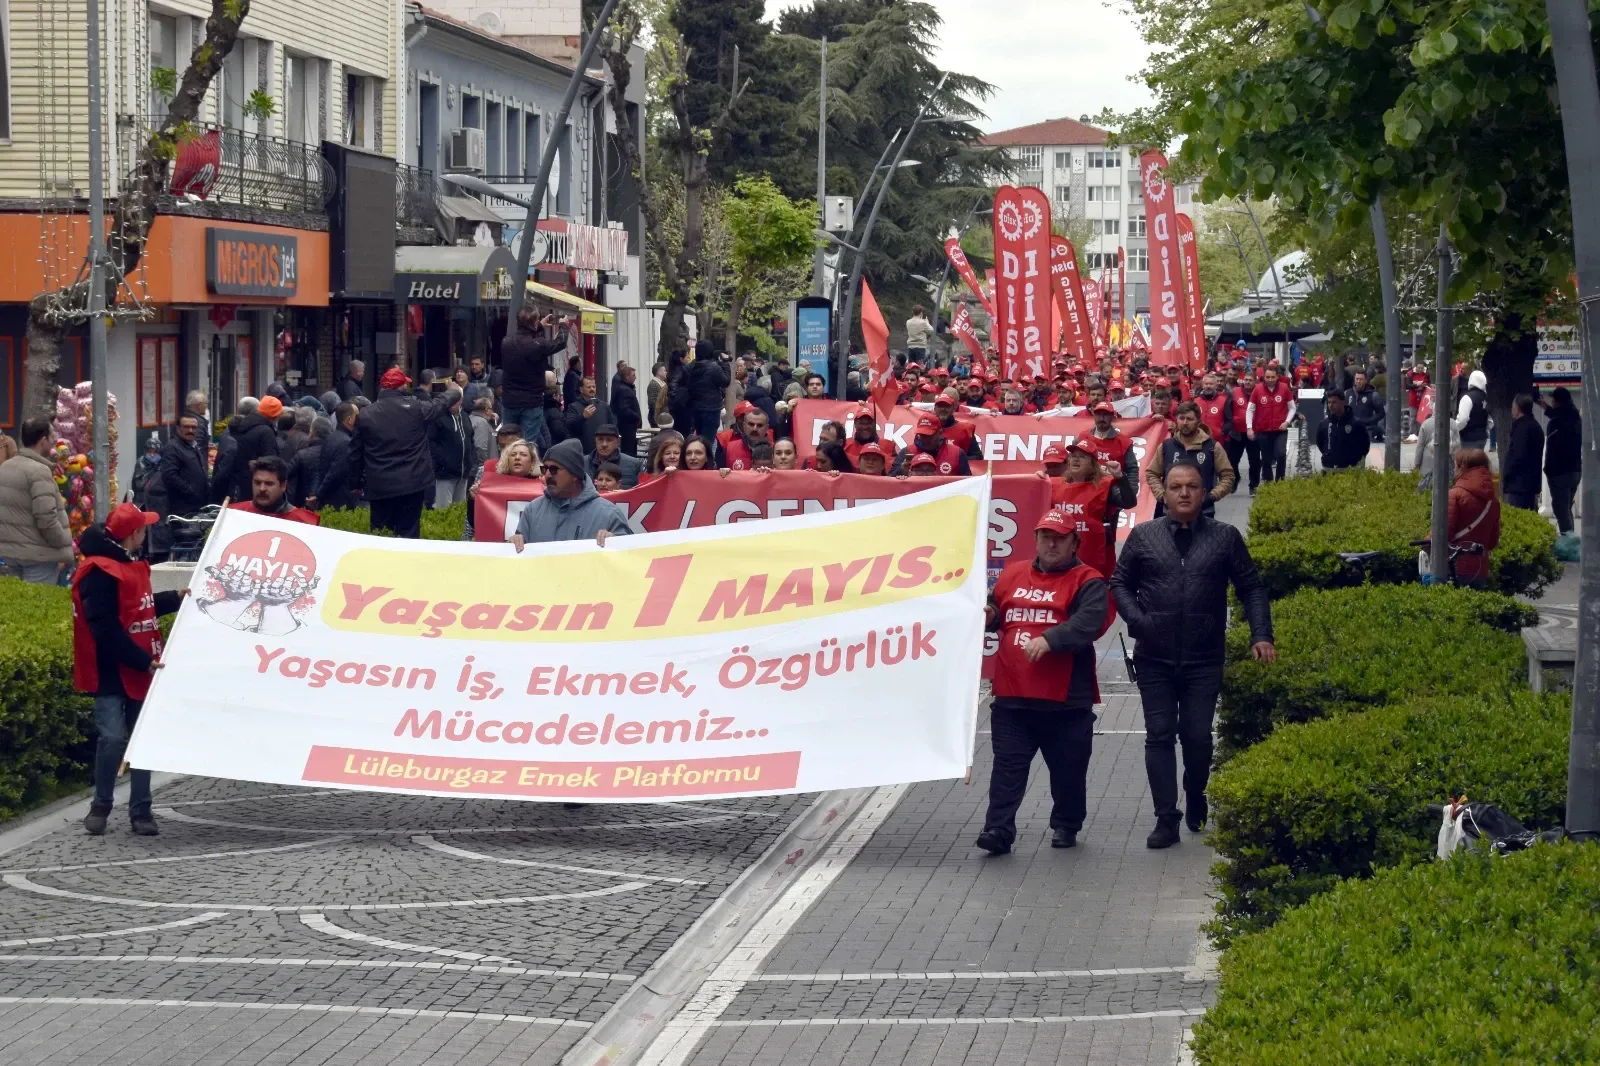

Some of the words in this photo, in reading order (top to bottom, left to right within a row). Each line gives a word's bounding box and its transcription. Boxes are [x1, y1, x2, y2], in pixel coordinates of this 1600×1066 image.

[280, 246, 295, 287] jet
[408, 281, 460, 299] Hotel
[268, 536, 281, 558] 1
[226, 552, 308, 581] MAYIS
[338, 582, 614, 638] Yaşasın
[633, 553, 694, 628] 1
[1013, 586, 1057, 602] DİSK
[1005, 607, 1058, 624] GENEL
[254, 644, 437, 691] Yaşasın
[456, 655, 505, 701] İş,
[526, 661, 697, 699] Ekmek,
[718, 621, 937, 691] Özgürlük
[393, 708, 769, 746] Mücadelemiz...
[343, 753, 507, 788] Lüleburgaz
[518, 766, 602, 788] Emek
[612, 763, 761, 788] Platformu
